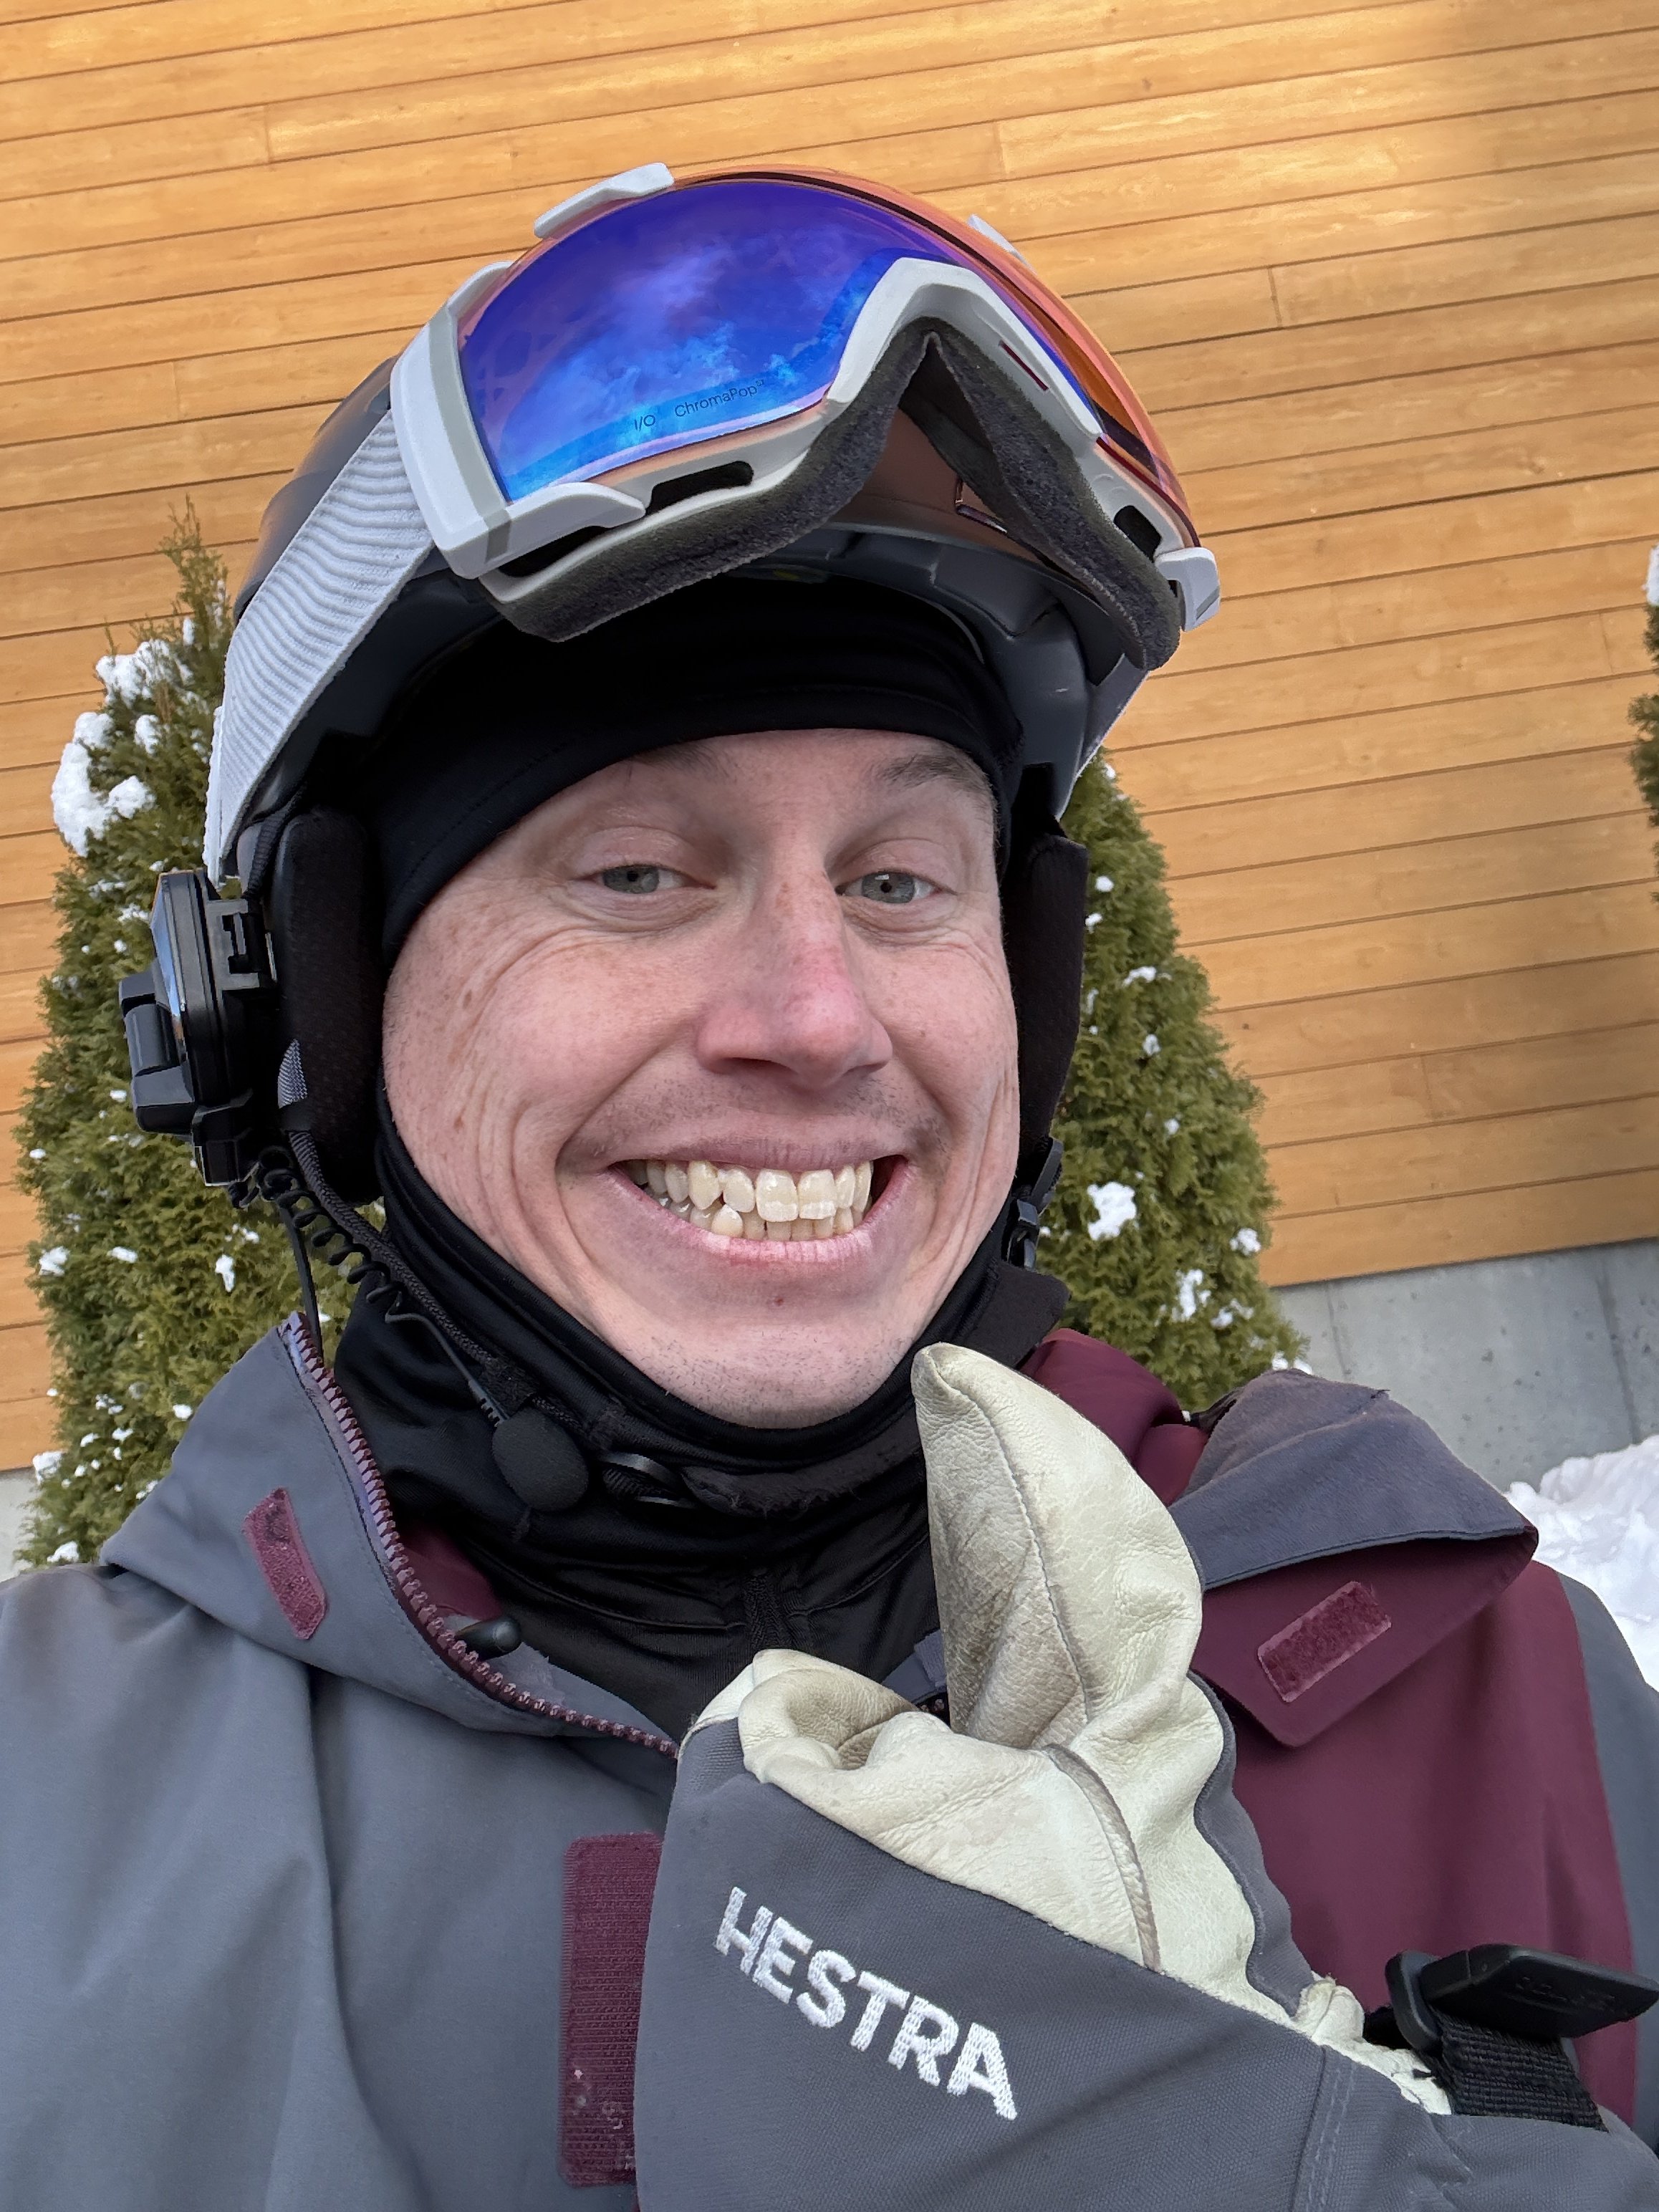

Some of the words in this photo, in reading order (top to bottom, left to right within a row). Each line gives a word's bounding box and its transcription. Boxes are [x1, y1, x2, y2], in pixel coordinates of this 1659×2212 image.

[634, 414, 656, 432] I/O
[674, 385, 758, 418] ChromaPop
[715, 1886, 1018, 2121] HESTRA
